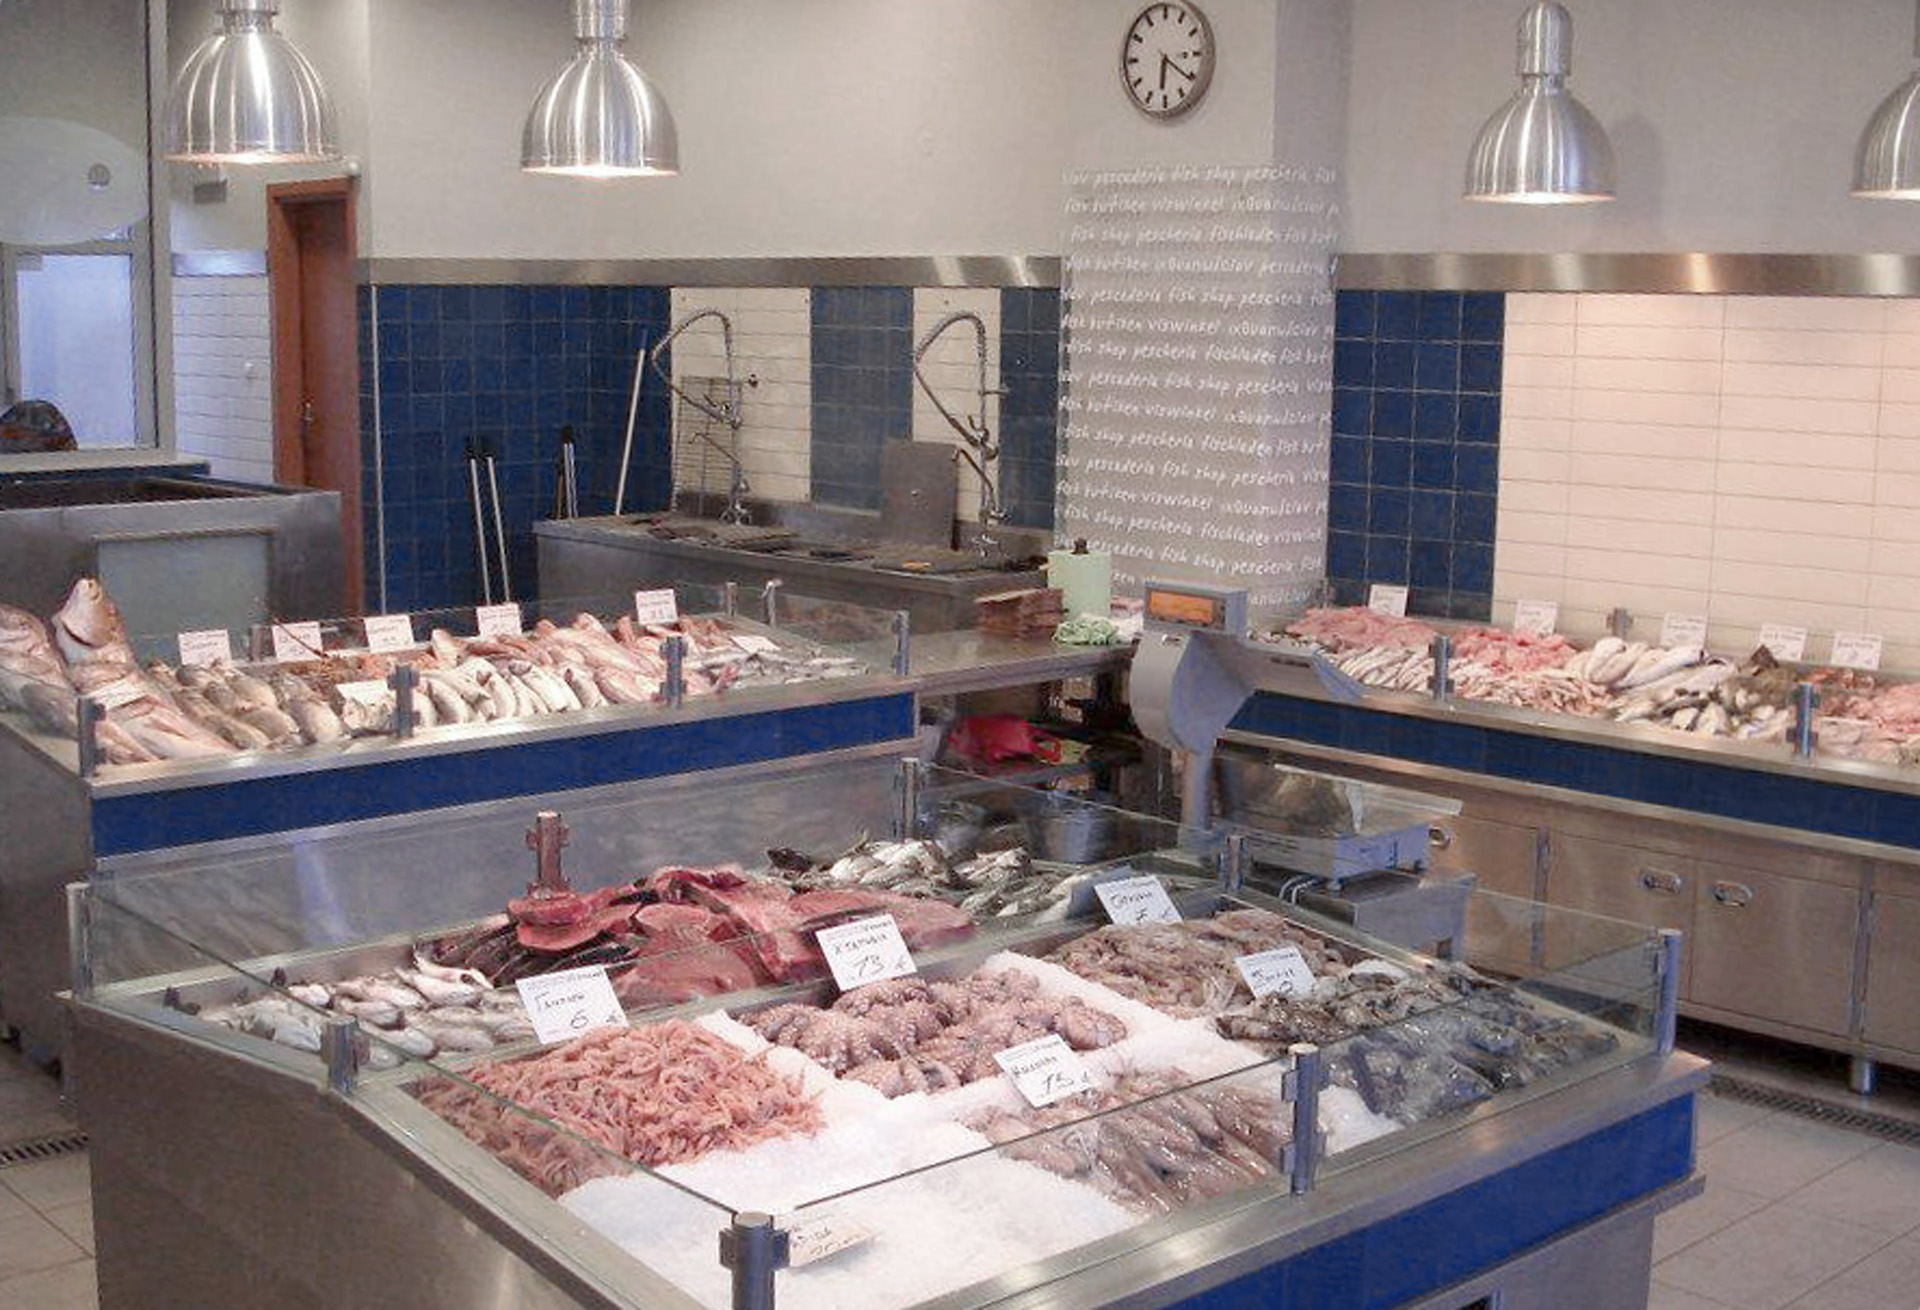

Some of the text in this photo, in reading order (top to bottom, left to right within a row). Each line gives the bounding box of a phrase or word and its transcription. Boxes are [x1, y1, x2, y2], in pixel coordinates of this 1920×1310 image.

[1161, 460, 1189, 478] fish
[1194, 466, 1226, 488] shop
[1064, 503, 1089, 520] fish
[1094, 508, 1124, 530] shop
[1161, 543, 1188, 563] fish
